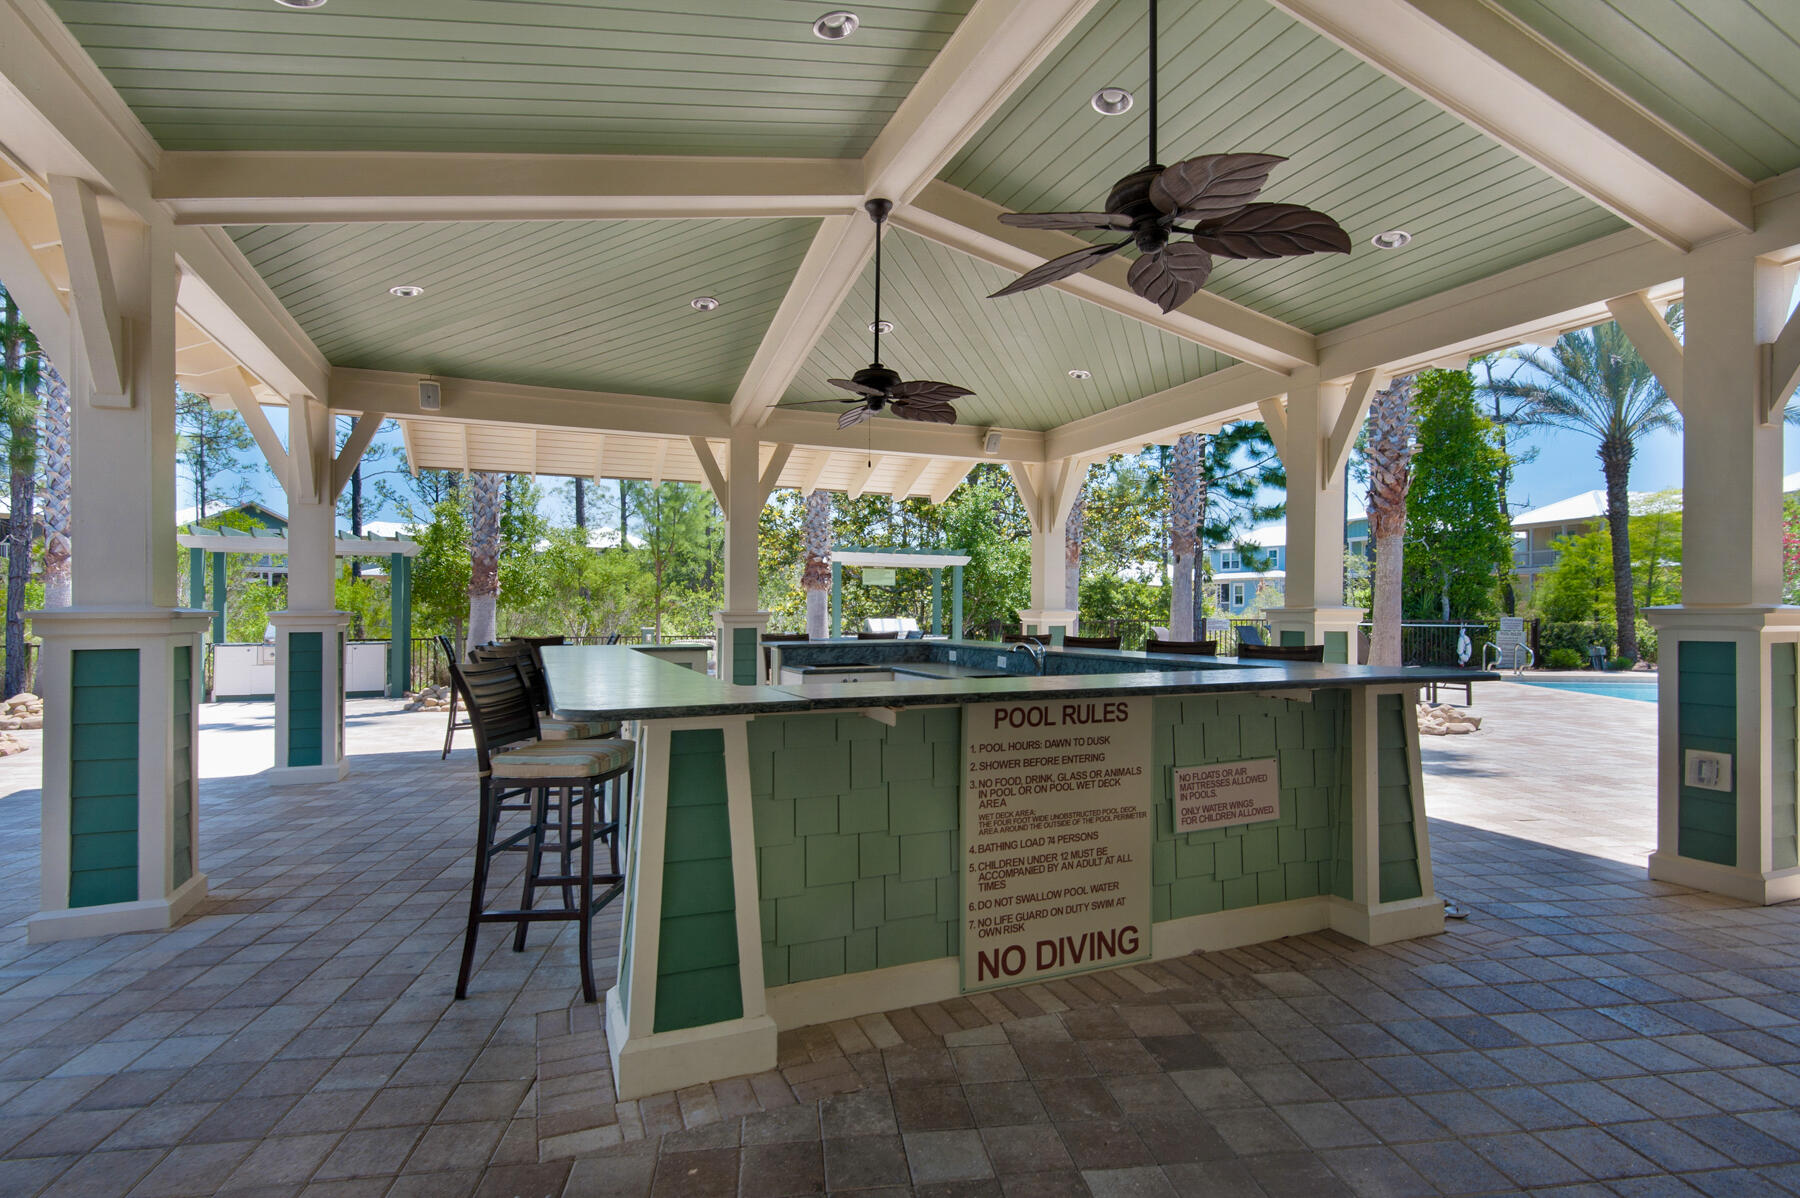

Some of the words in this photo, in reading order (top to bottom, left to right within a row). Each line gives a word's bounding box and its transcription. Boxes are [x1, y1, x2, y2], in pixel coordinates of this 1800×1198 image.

[994, 706, 1056, 729] POOL
[1062, 702, 1129, 725] RULES
[970, 744, 976, 754] 1.
[979, 743, 1006, 752] POOL
[1008, 740, 1042, 750] HOURS:
[1044, 738, 1071, 748] DAWN
[1072, 738, 1084, 746] TO
[1087, 736, 1110, 746] DUSK
[970, 762, 978, 772] 2.
[979, 760, 1020, 770] SHOWER
[1023, 756, 1060, 767] BEFORE
[1062, 753, 1106, 764] ENTERING
[970, 780, 977, 789] 3.
[978, 778, 992, 788] NO
[1058, 770, 1088, 782] GLASS
[1089, 770, 1102, 779] OR
[1104, 766, 1142, 778] ANIMALS
[1180, 774, 1190, 782] NO
[1192, 770, 1220, 780] FLOATS
[1222, 768, 1233, 777] OR
[1234, 768, 1247, 776] AIR
[1180, 778, 1230, 791] MATTRESSES
[1232, 774, 1268, 786] ALLOWED
[979, 789, 987, 798] IN
[990, 788, 1016, 798] POOL
[1018, 786, 1032, 795] OR
[1034, 784, 1048, 794] ON
[1050, 782, 1074, 792] POOL
[1076, 780, 1096, 790] WET
[1098, 778, 1121, 788] DECK
[1180, 792, 1188, 801] IN
[978, 798, 1007, 809] AREA
[1182, 806, 1200, 816] ONLY
[1202, 802, 1228, 813] WATER
[1229, 798, 1254, 810] WINGS
[978, 812, 994, 820] WET
[996, 811, 1014, 819] DECK
[994, 818, 1012, 826] FOUR
[1012, 816, 1030, 824] FOOT
[1050, 810, 1100, 820] UNOBSTRUCTED
[1182, 816, 1198, 825] FOR
[1199, 811, 1236, 822] CHILDREN
[979, 827, 998, 836] AREA
[1000, 824, 1028, 833] AROUND
[1044, 820, 1071, 828] OUTSIDE
[969, 845, 977, 854] 4.
[978, 840, 1018, 854] BATHING
[1020, 838, 1046, 848] LOAD
[1047, 836, 1056, 845] 74
[1058, 832, 1099, 844] PERSONS
[969, 864, 976, 872] 5.
[978, 857, 1025, 871] CHILDREN
[1027, 853, 1058, 864] UNDER
[1060, 852, 1068, 860] 12
[1070, 848, 1094, 860] MUST
[1096, 846, 1108, 856] BE
[978, 864, 1046, 881] ACCOMPANIED
[1048, 863, 1059, 872] BY
[1061, 861, 1074, 871] AN
[1076, 857, 1103, 868] ADULT
[1104, 856, 1115, 865] AT
[1116, 853, 1133, 864] ALL
[978, 880, 1006, 892] TIMES
[968, 902, 976, 912] 6.
[978, 900, 992, 910] DO
[994, 896, 1014, 908] NOT
[1016, 890, 1062, 904] SWALLOW
[1064, 886, 1088, 898] POOL
[1090, 882, 1120, 894] WATER
[968, 920, 976, 930] 7.
[978, 918, 992, 928] NO
[994, 914, 1013, 926] LIFE
[1016, 908, 1048, 922] GUARD
[1050, 907, 1064, 917] ON
[1066, 902, 1090, 914] DUTY
[1091, 899, 1114, 910] SWIM
[1116, 896, 1126, 906] AT
[978, 926, 1002, 938] OWN
[1004, 923, 1025, 934] RISK
[978, 945, 1026, 982] NO
[1036, 926, 1140, 971] DIVING
